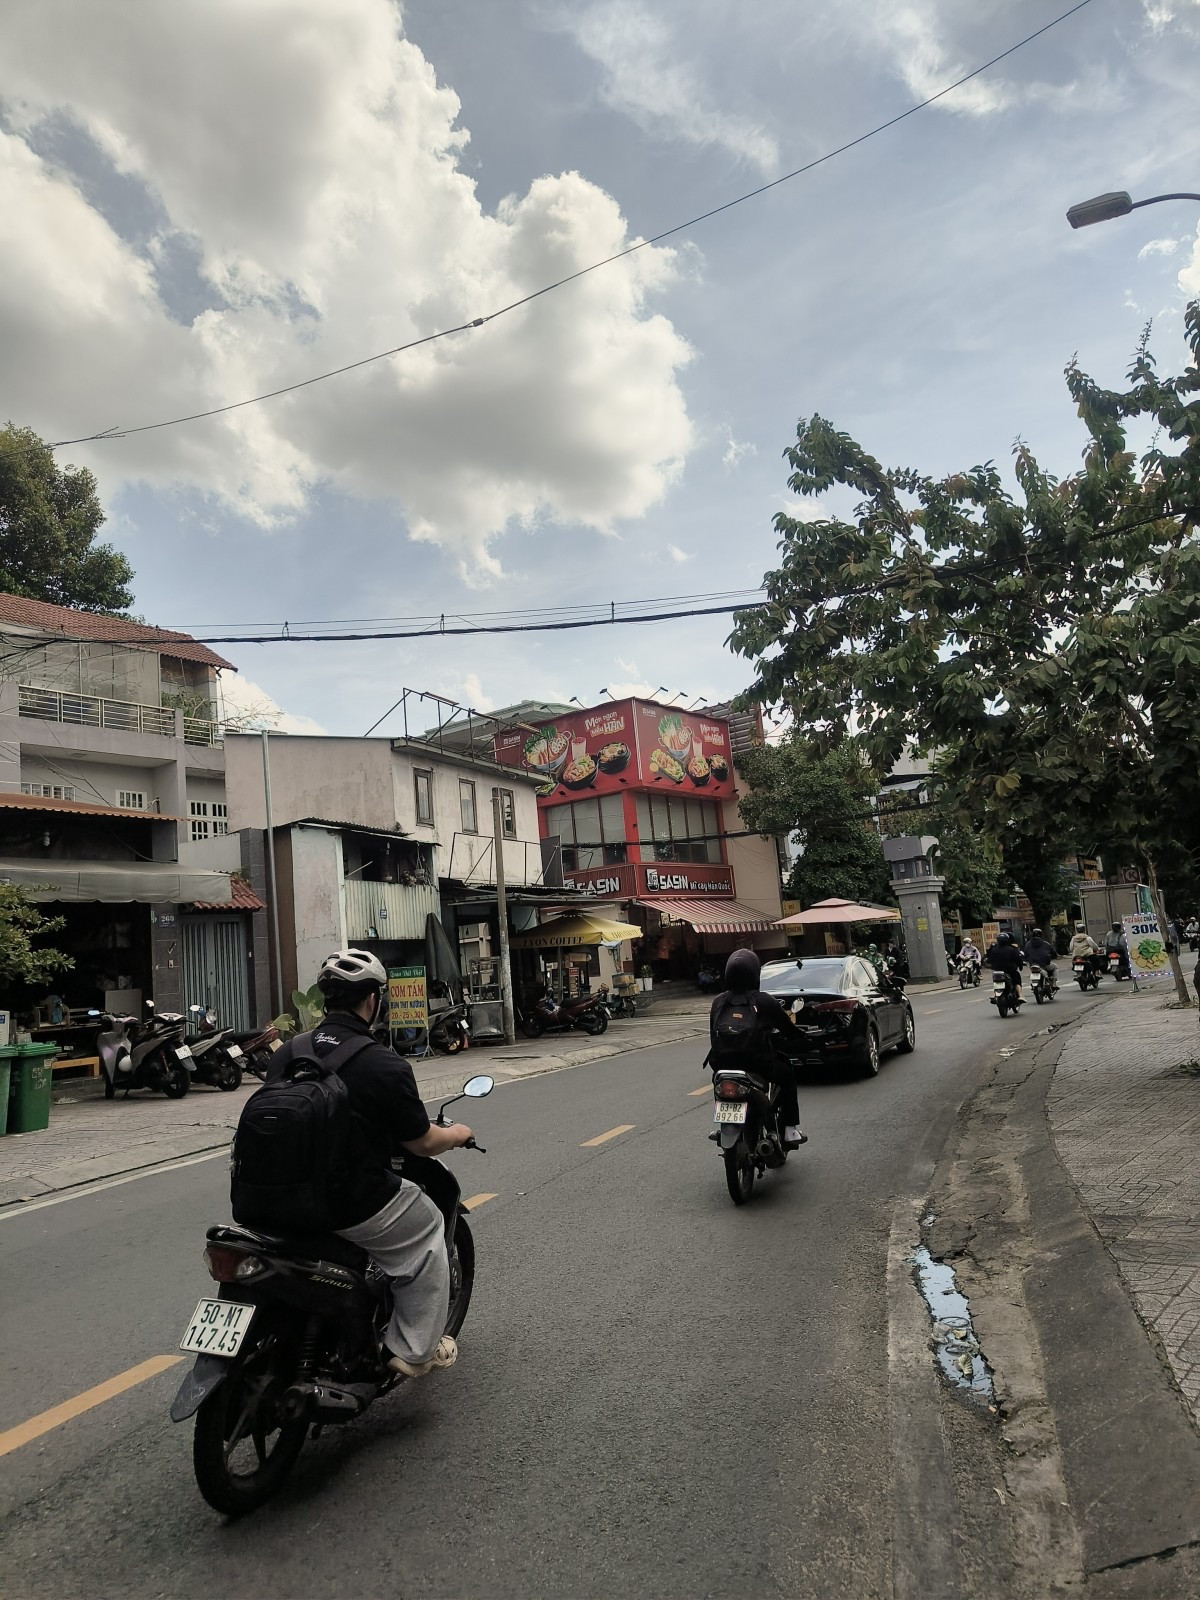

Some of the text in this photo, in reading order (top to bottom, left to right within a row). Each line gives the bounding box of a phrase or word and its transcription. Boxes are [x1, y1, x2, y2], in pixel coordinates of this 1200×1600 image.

[660, 875, 689, 890] SASIN
[698, 882, 708, 891] cay
[1131, 923, 1159, 935] 30K
[550, 935, 584, 946] COFFEE
[408, 979, 424, 997] TẤM
[187, 1326, 241, 1352] 147.45
